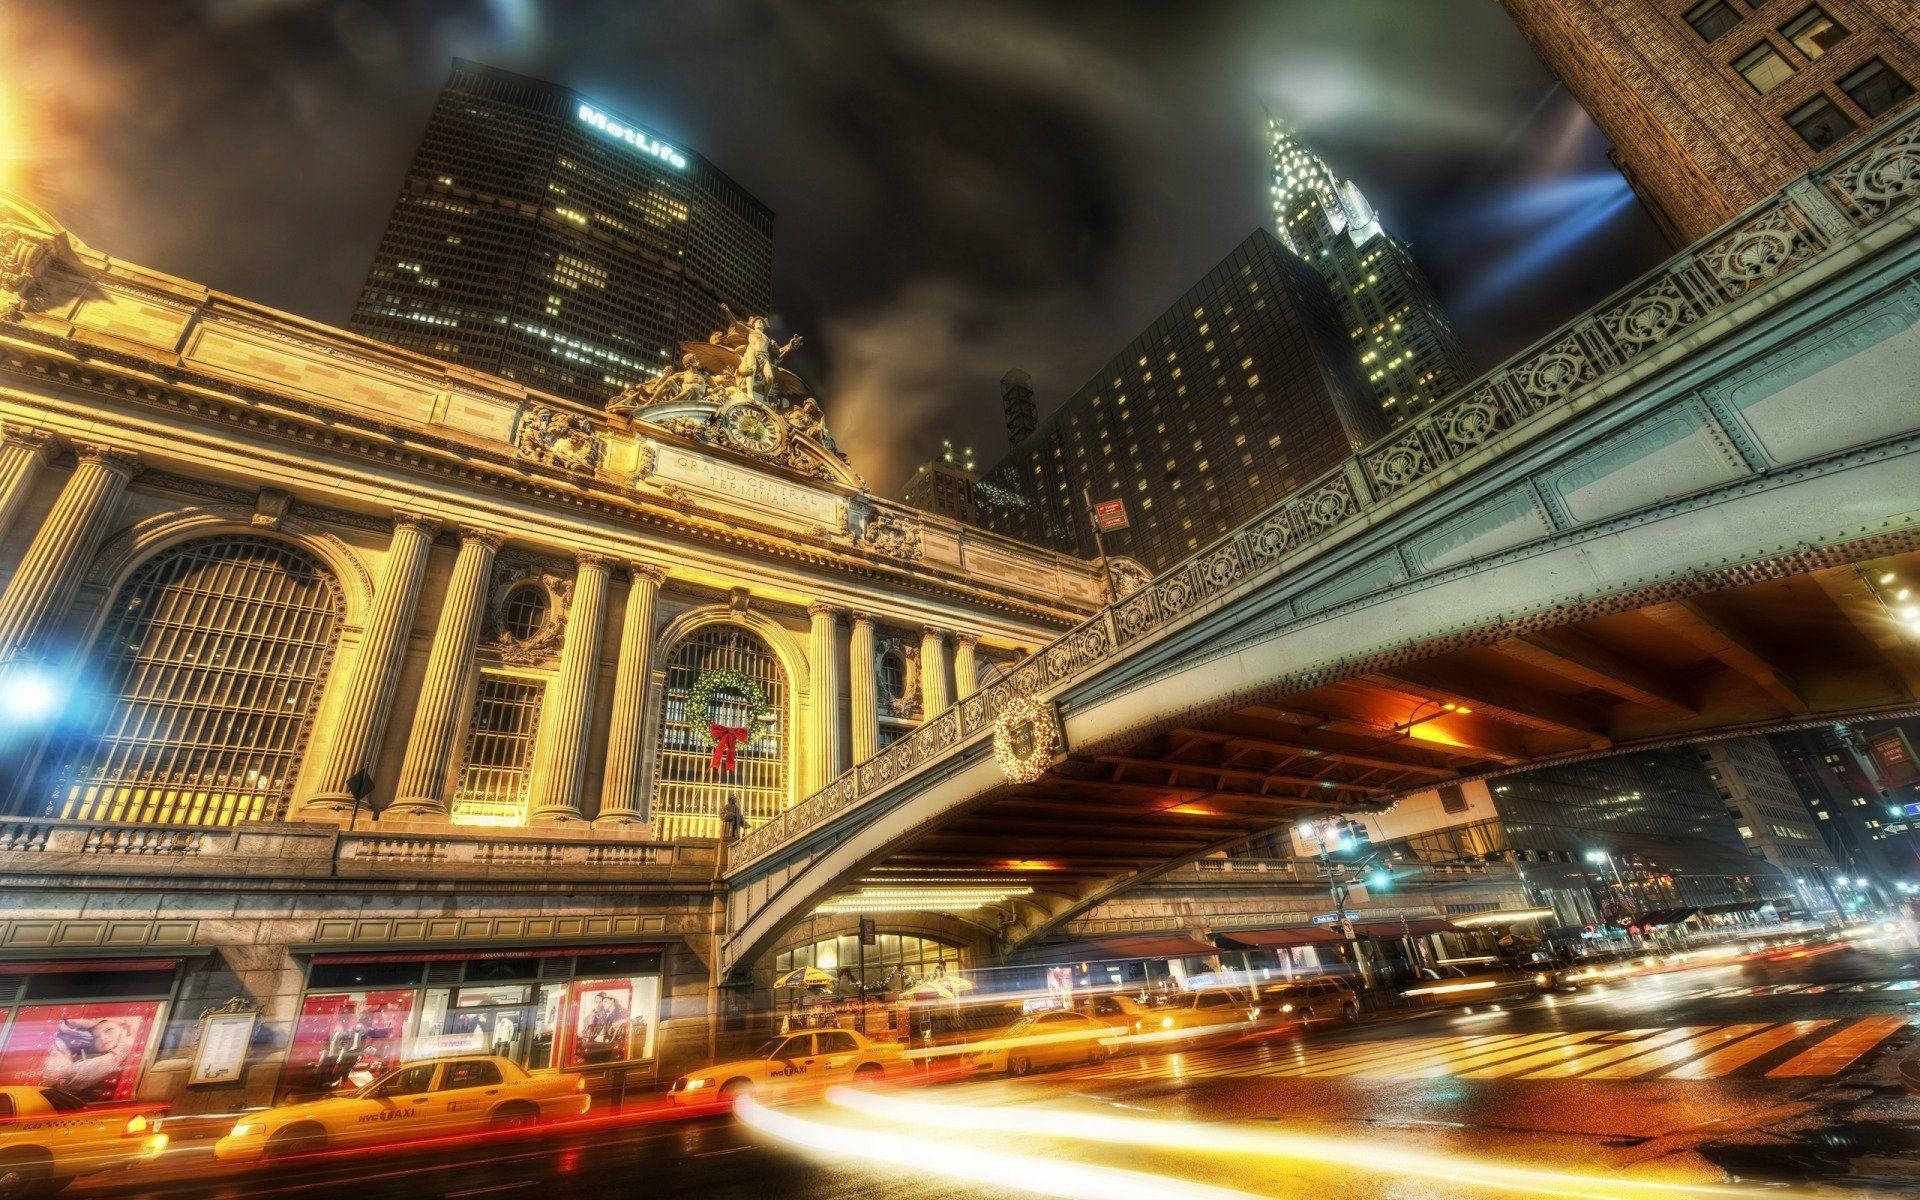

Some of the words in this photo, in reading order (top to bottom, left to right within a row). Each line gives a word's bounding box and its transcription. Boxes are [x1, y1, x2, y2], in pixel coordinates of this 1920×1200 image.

[578, 105, 686, 168] MetLife
[677, 457, 736, 480] GRAND
[747, 477, 817, 505] CENTRAL
[710, 476, 790, 507] TERMINAL
